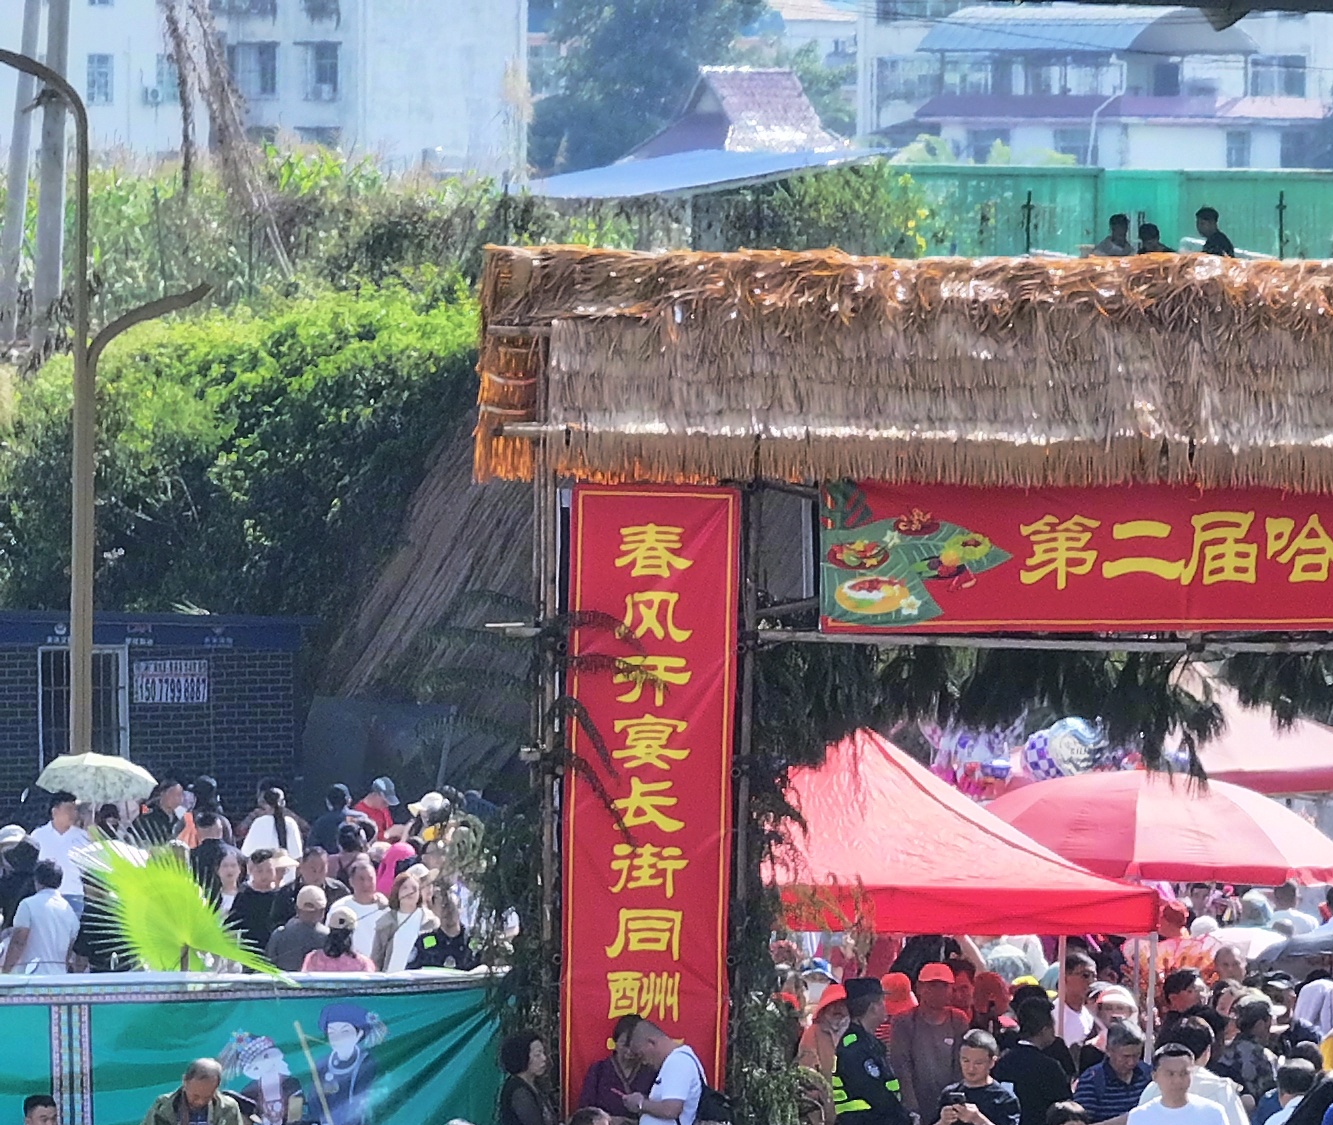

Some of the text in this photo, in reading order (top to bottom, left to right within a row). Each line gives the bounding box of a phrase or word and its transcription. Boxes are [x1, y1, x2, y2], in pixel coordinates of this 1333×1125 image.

[606, 522, 693, 1050] 春风开宴长街同酬
